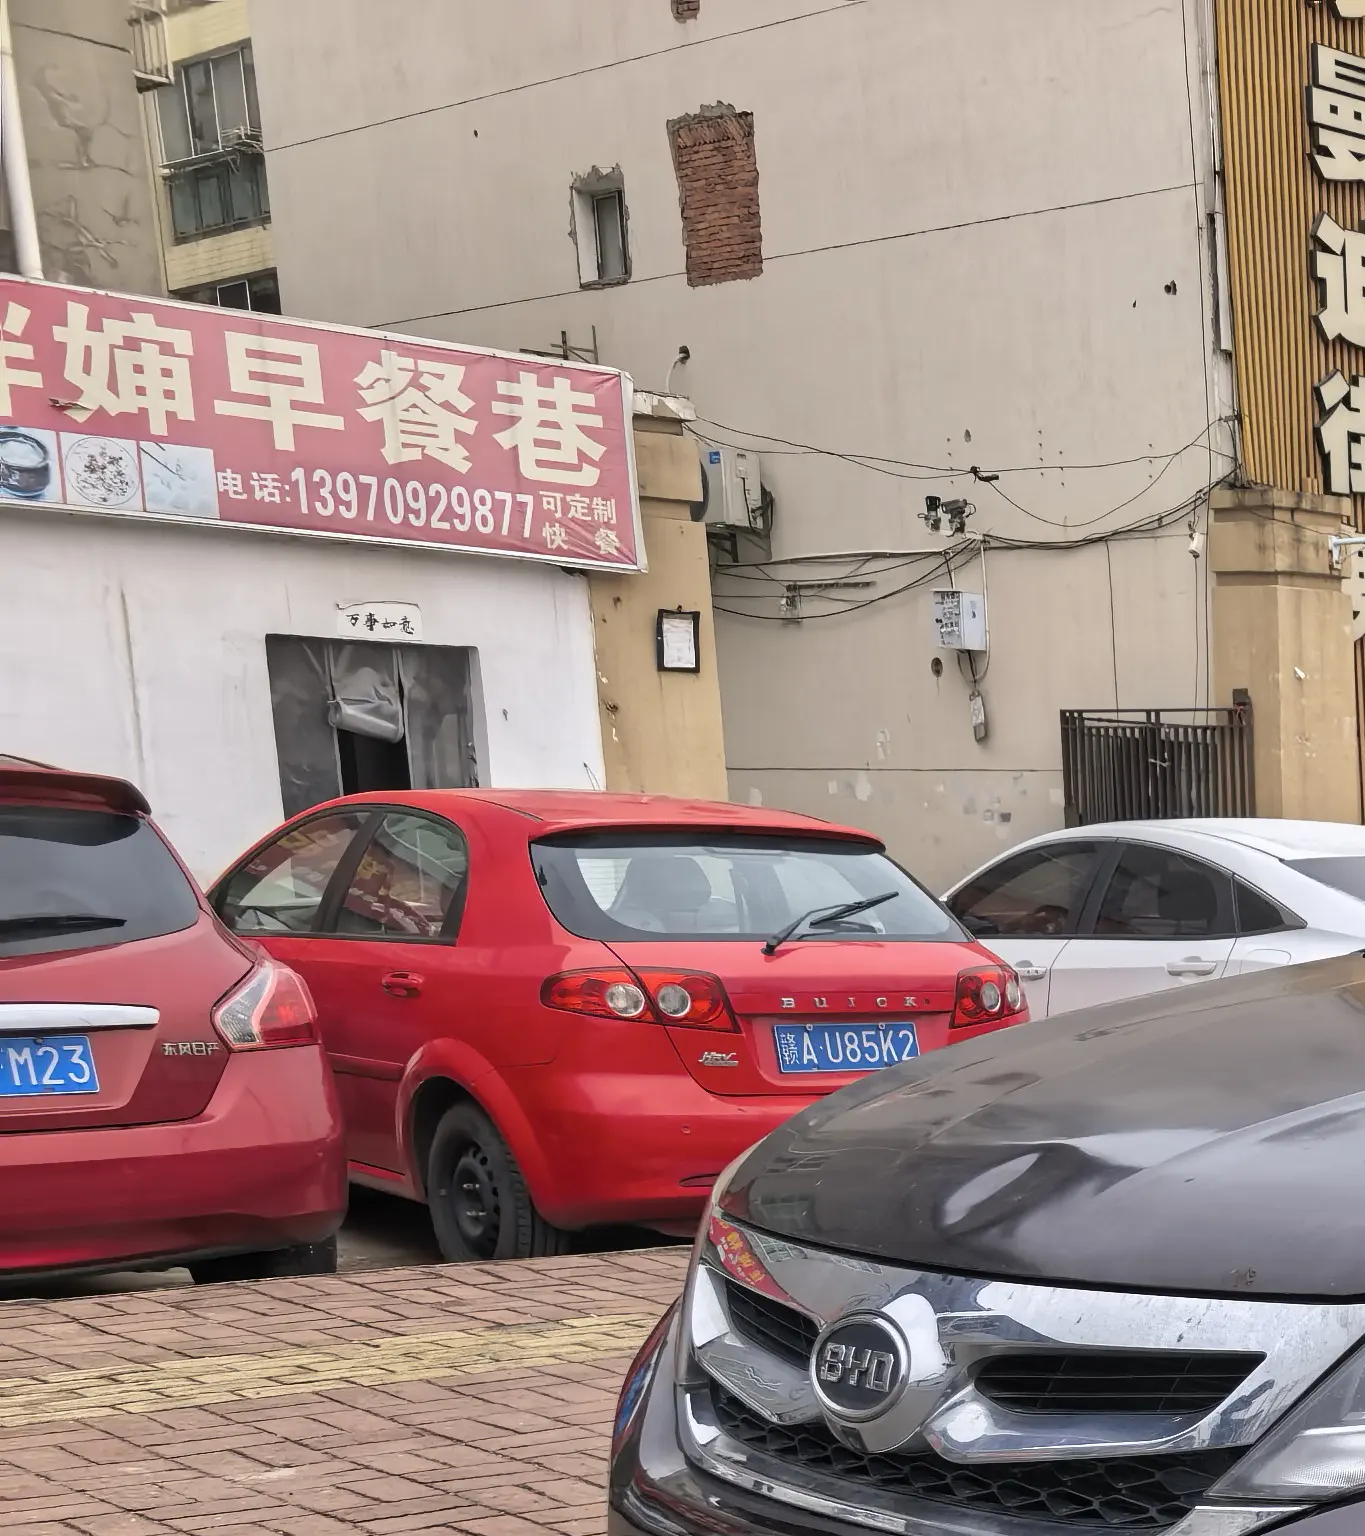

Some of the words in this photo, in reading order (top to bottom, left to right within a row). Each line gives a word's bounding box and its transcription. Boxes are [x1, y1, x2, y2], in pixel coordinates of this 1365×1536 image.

[538, 489, 618, 526] 可定制
[345, 611, 417, 637] 万事如意
[781, 996, 919, 1009] BUICK
[162, 1041, 220, 1057] 东风日产
[0, 1044, 92, 1087] M23
[819, 1341, 895, 1393] BYD
